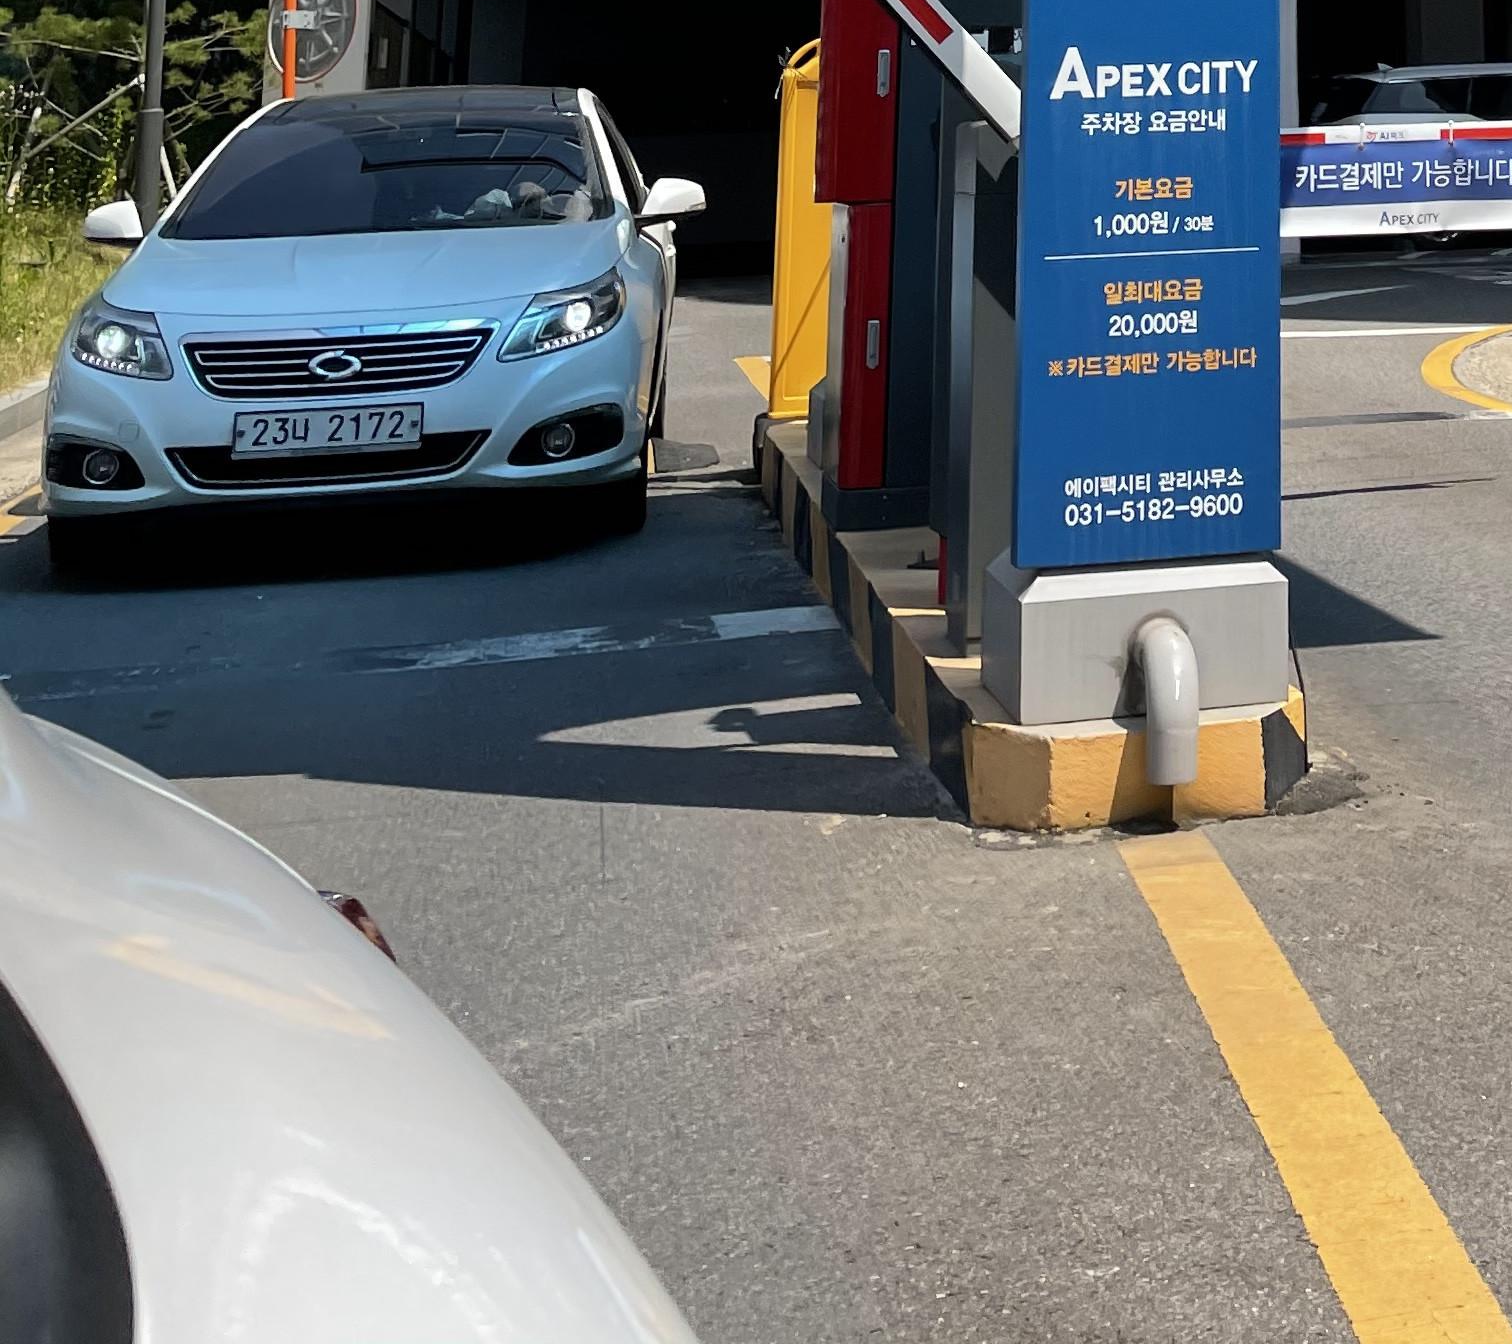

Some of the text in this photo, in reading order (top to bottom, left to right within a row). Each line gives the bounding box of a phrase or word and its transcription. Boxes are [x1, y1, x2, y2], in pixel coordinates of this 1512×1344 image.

[1050, 46, 1258, 100] APEX CITY
[1081, 108, 1227, 136] 주차장 요금안내
[1115, 176, 1194, 201] 기본요금
[1295, 162, 1404, 193] 카드결제만
[1094, 211, 1169, 238] 1,000원
[1183, 215, 1215, 232] 30분
[1417, 212, 1440, 224] CITY
[1103, 278, 1204, 305] 일최대요금
[1108, 310, 1199, 338] 20,000원
[1066, 352, 1160, 378] 카드결제만
[1166, 347, 1257, 373] 가능합니다
[327, 410, 405, 442] 2172
[1064, 468, 1244, 499] 에이팩시티 관리사무소
[1064, 493, 1244, 527] 031-5182-9600
